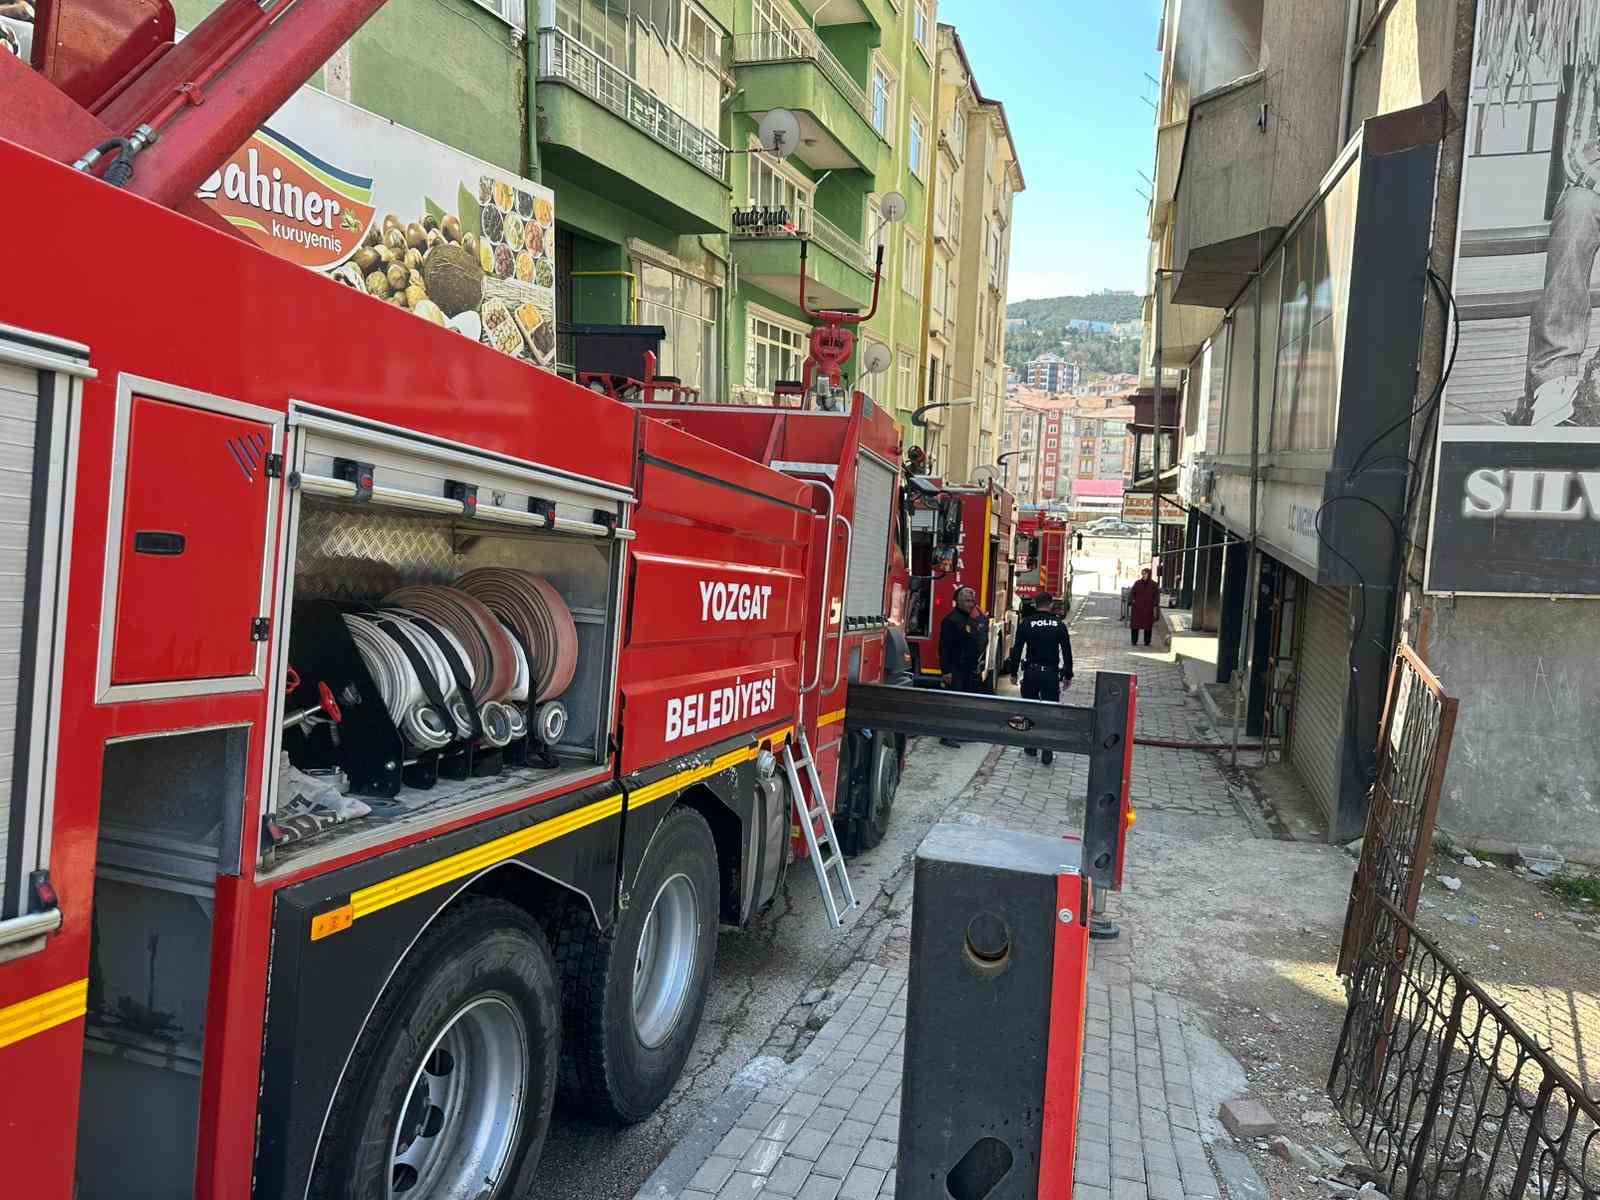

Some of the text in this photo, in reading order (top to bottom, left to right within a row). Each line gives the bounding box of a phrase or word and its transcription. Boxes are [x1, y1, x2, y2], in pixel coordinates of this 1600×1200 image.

[272, 220, 342, 254] kuruyemiş
[699, 580, 772, 622] YOZGAT
[665, 668, 776, 743] BELEDİYESİ
